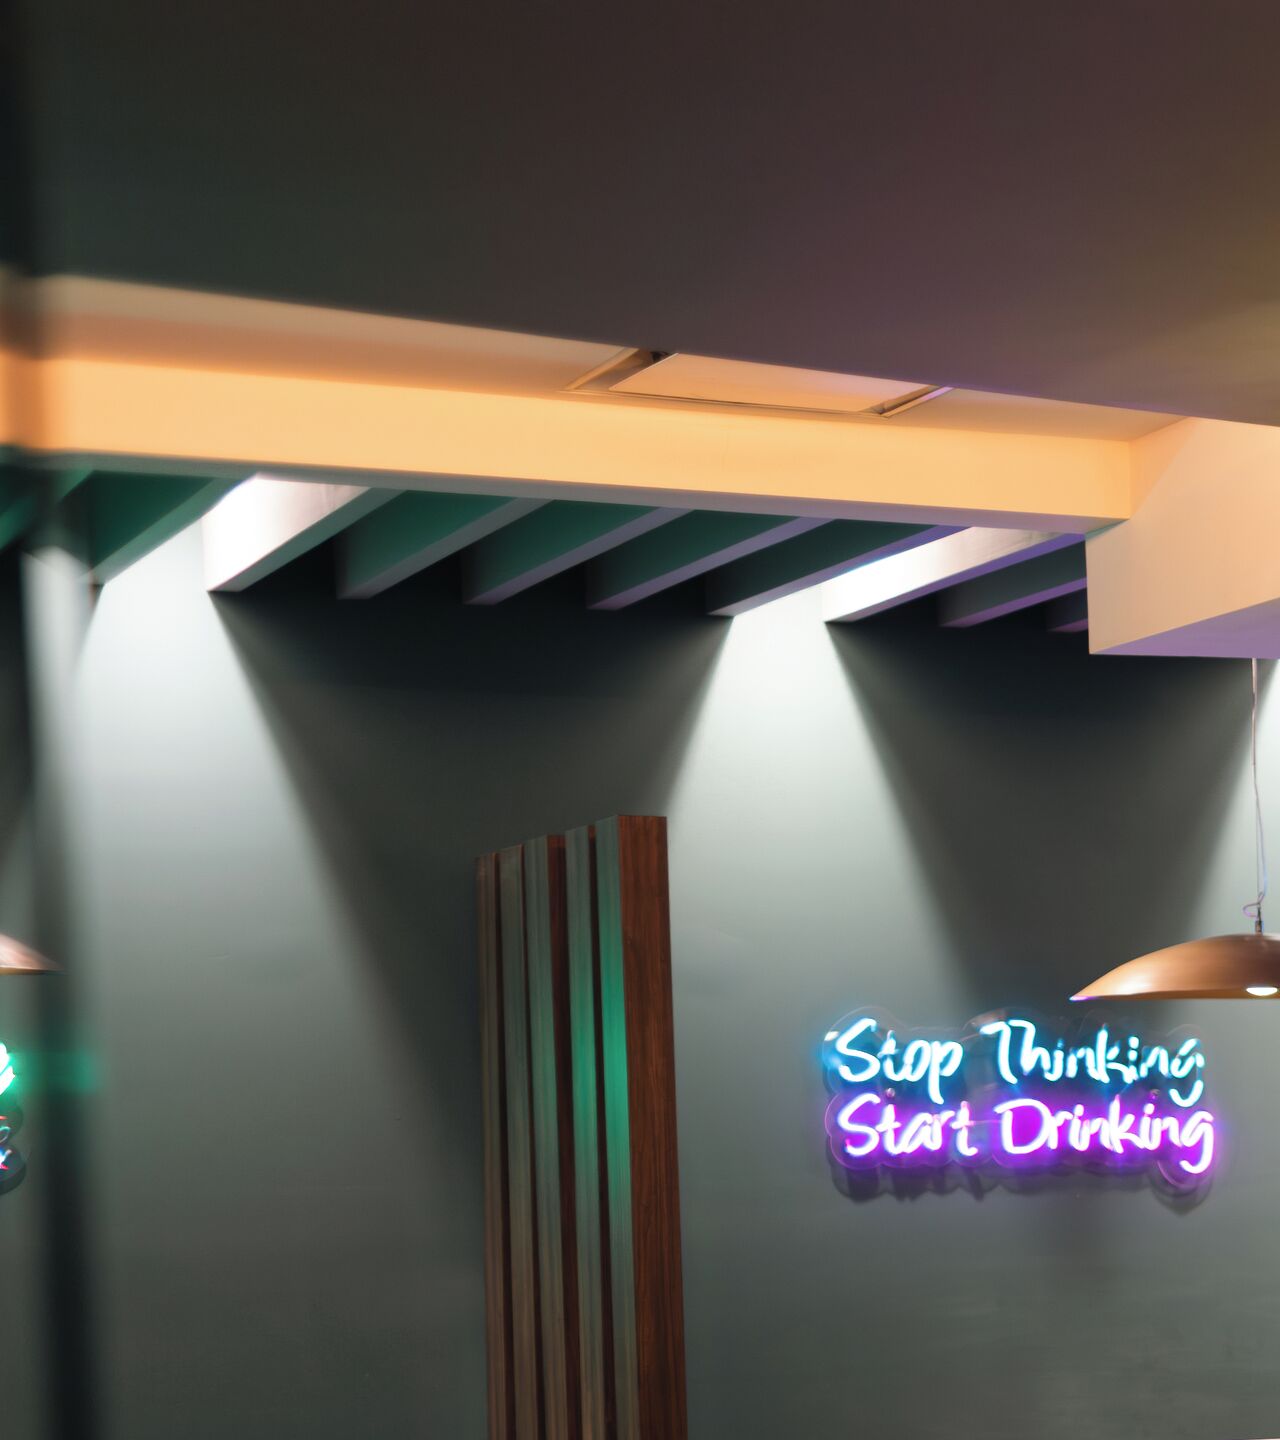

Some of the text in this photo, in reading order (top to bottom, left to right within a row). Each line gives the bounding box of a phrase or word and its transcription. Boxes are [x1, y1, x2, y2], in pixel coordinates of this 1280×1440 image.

[836, 1018, 1204, 1107] Stop Thinking
[838, 1092, 1214, 1174] Start Drinking
